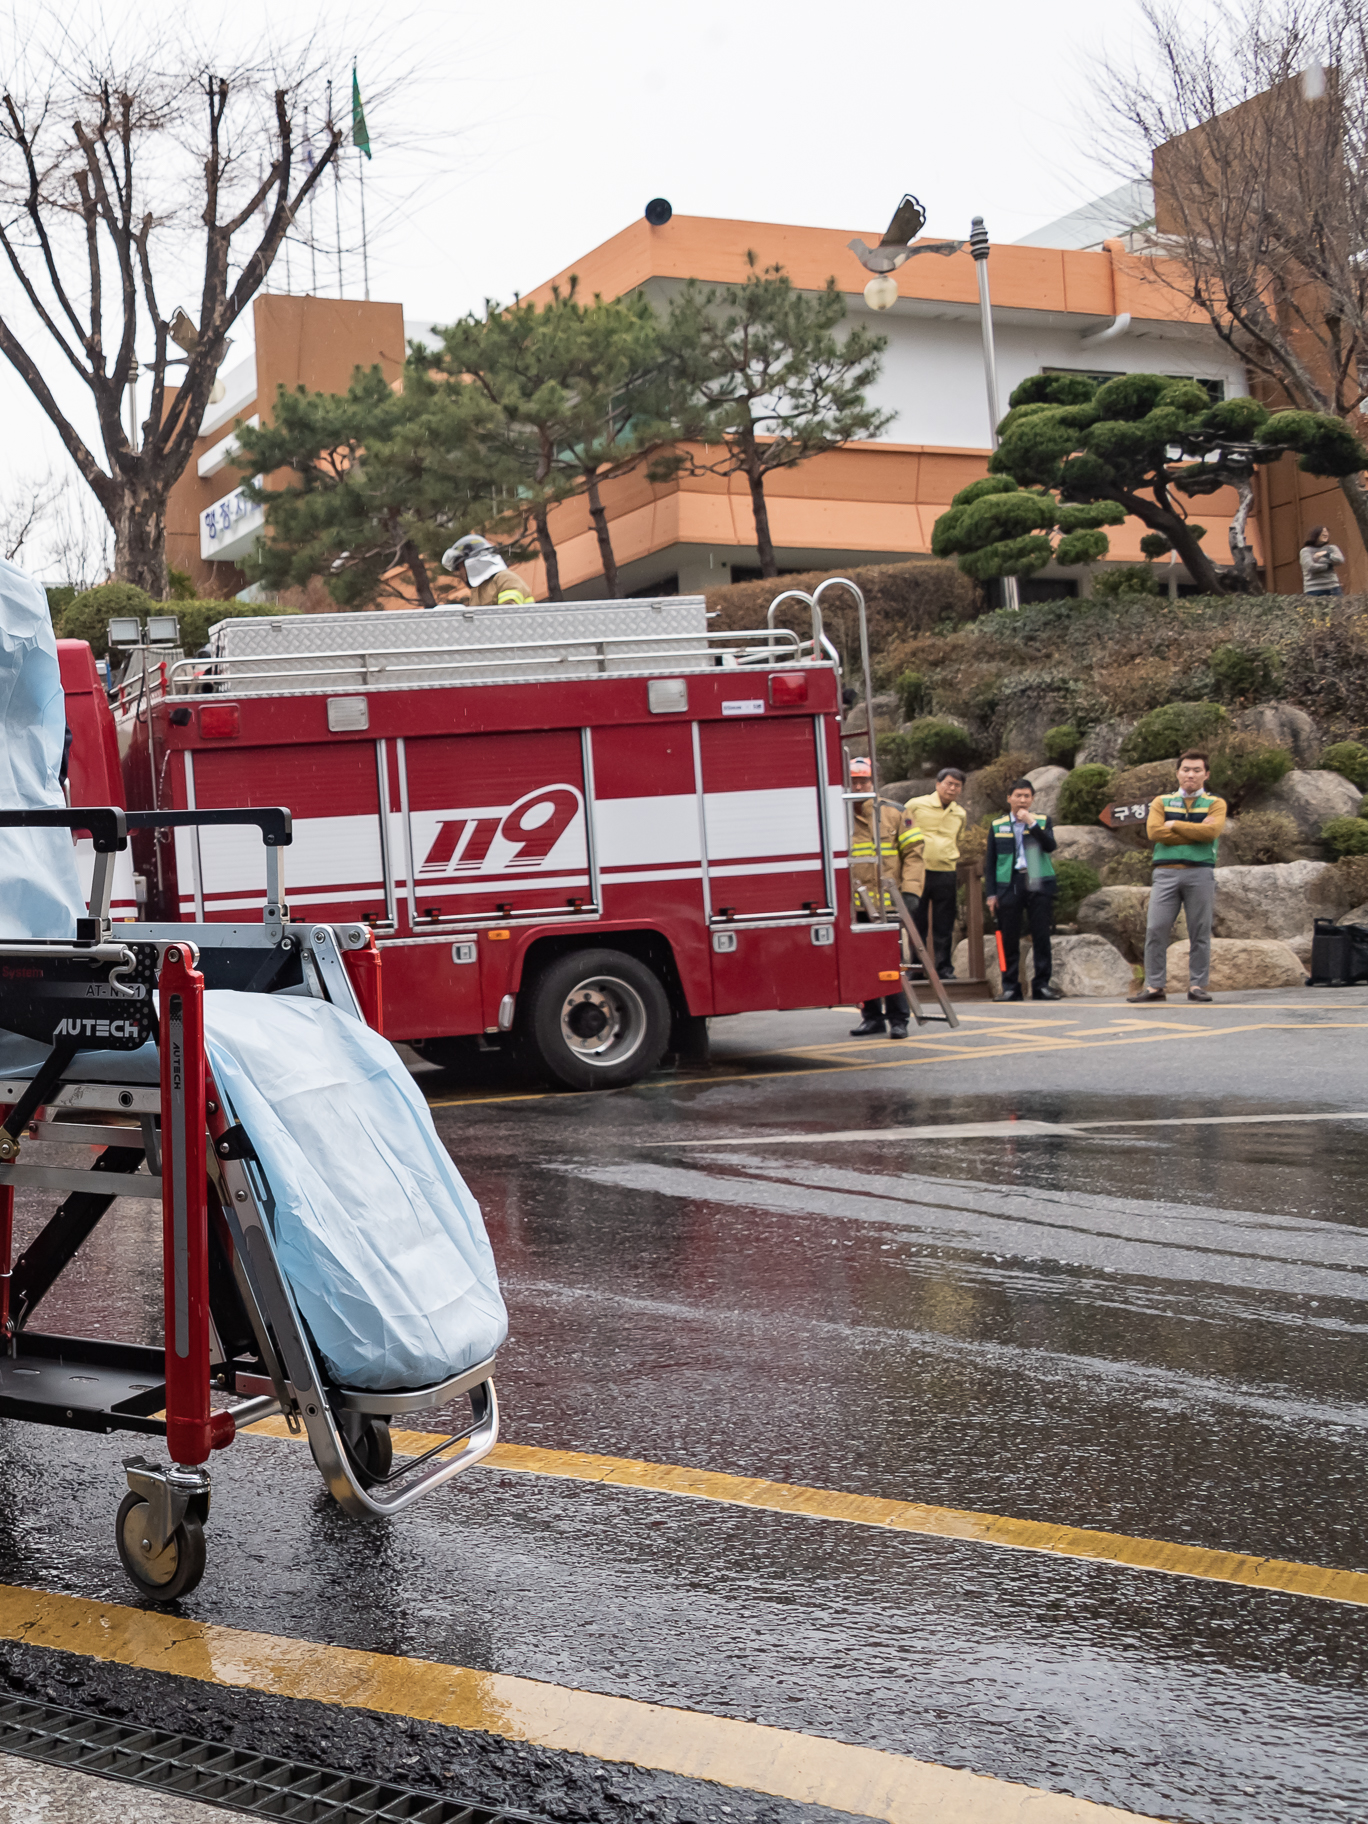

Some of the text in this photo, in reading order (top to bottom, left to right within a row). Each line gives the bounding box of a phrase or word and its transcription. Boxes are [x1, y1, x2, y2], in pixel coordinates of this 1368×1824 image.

[1114, 803, 1152, 821] 구청
[418, 788, 579, 873] 119
[2, 965, 44, 980] System
[53, 1018, 139, 1038] AUTECH
[172, 1041, 181, 1090] AUTECH
